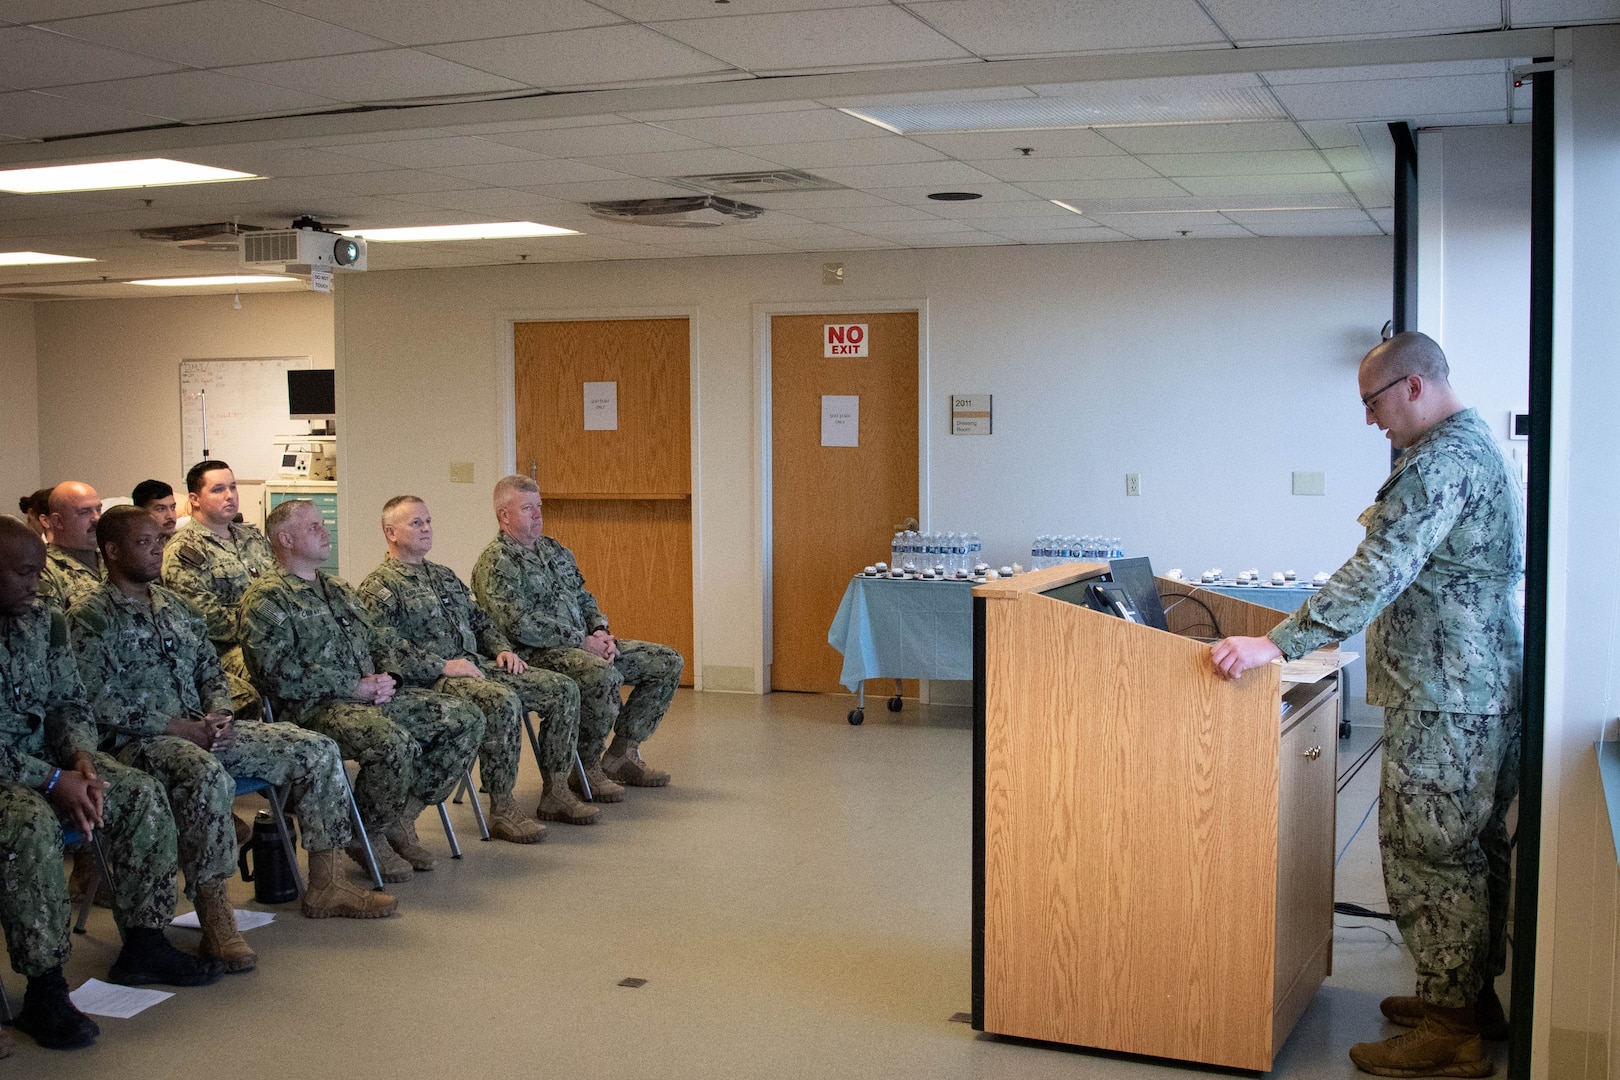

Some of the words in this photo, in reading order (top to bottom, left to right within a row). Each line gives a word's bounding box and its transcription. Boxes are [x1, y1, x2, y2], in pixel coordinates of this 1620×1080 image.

[828, 325, 864, 344] NO
[832, 345, 860, 354] EXIT
[955, 399, 972, 407] 2011
